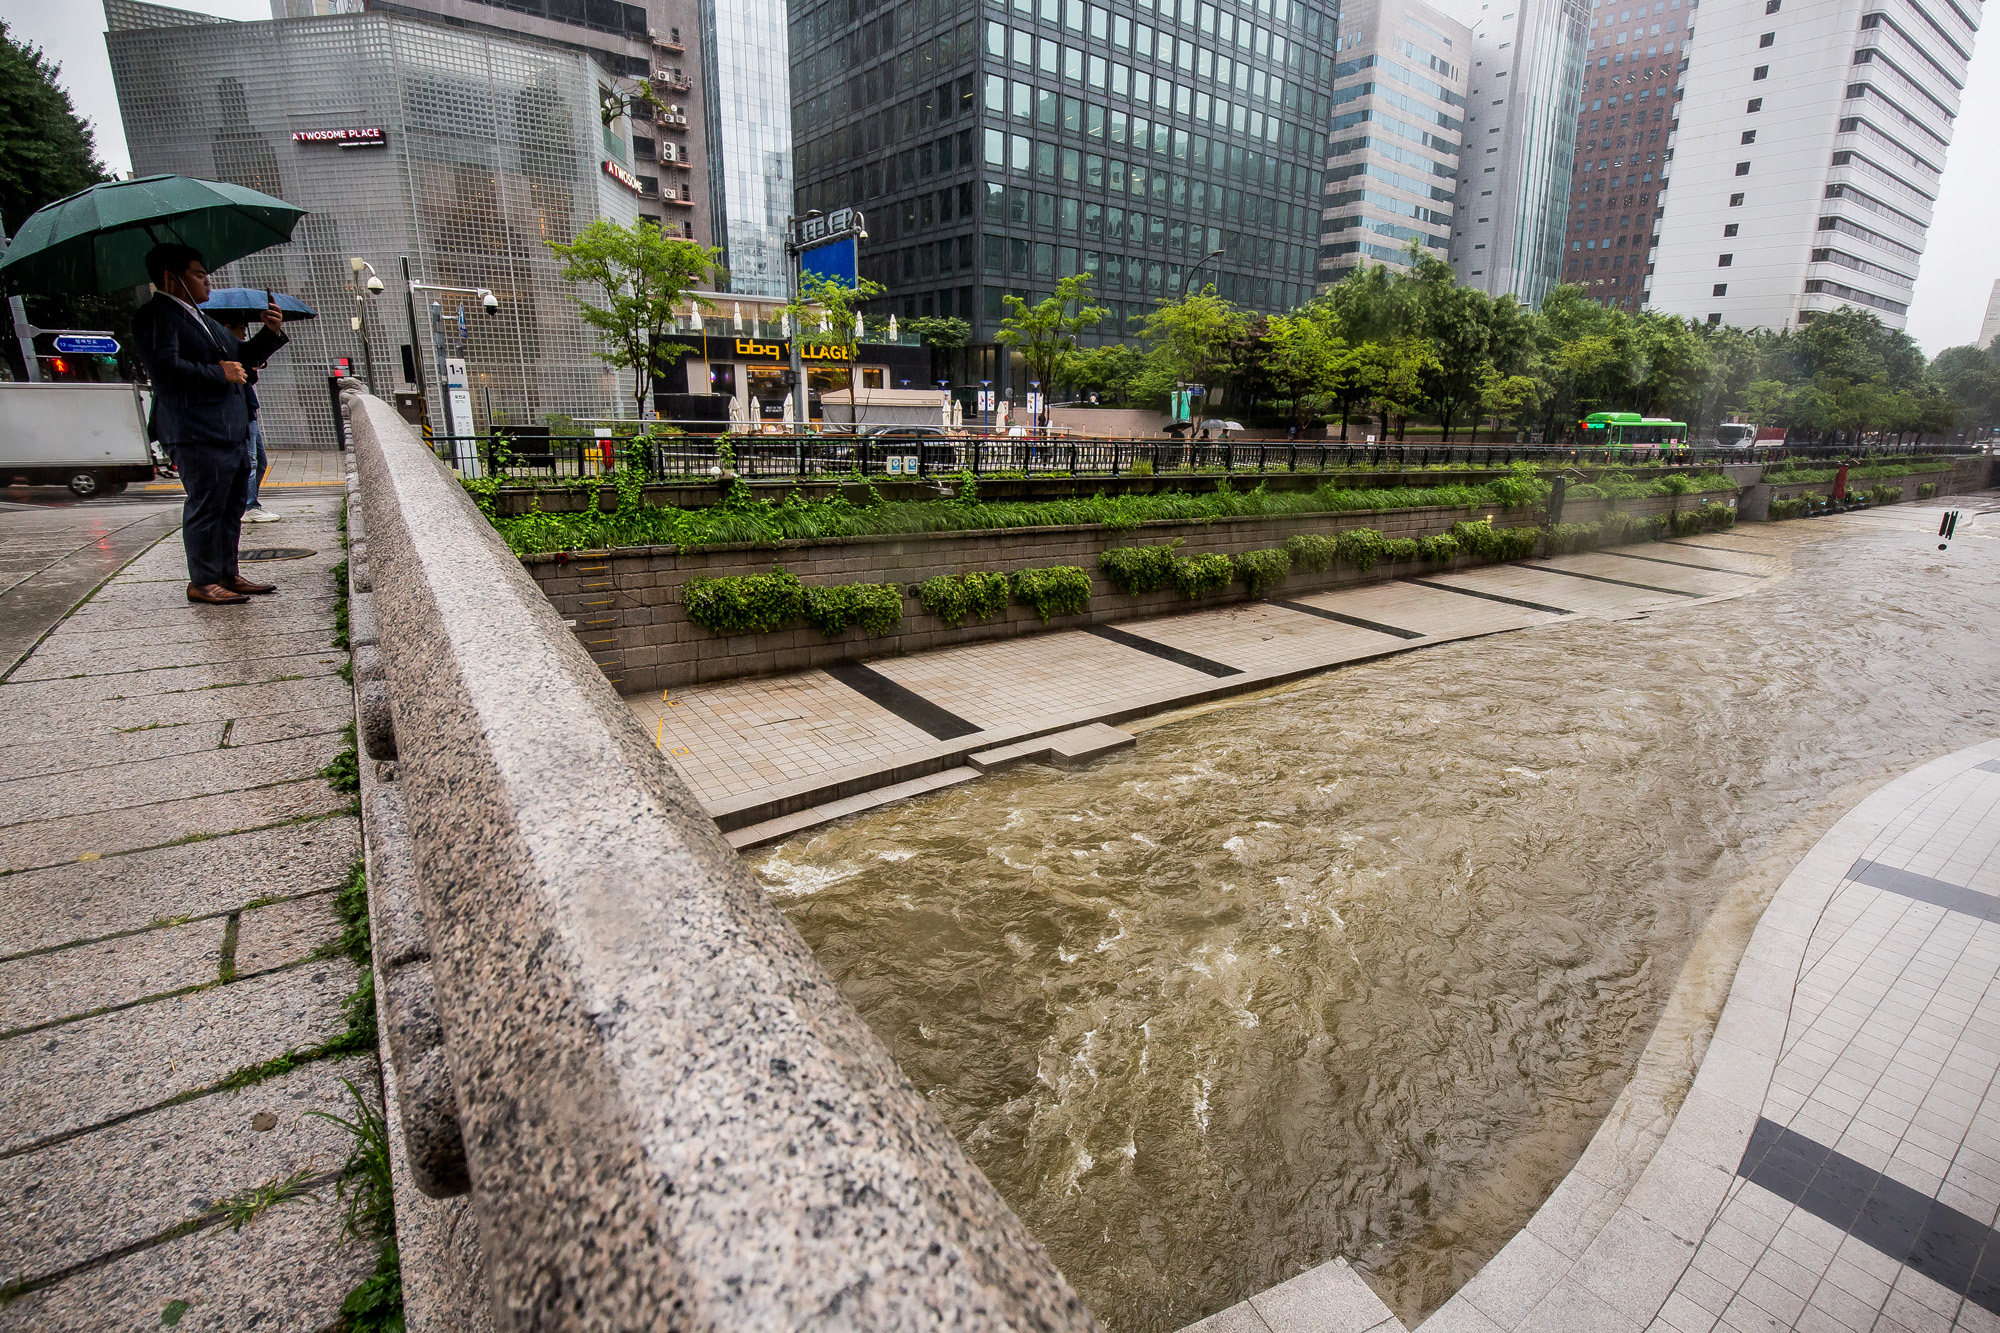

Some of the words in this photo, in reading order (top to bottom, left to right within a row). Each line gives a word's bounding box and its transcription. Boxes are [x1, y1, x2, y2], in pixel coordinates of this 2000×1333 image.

[292, 132, 300, 141] A
[300, 130, 347, 140] TWOSOME
[349, 128, 380, 138] PLACE
[613, 163, 643, 194] TWOSOME
[784, 343, 849, 360] VLLAGE
[449, 364, 464, 376] 1-1
